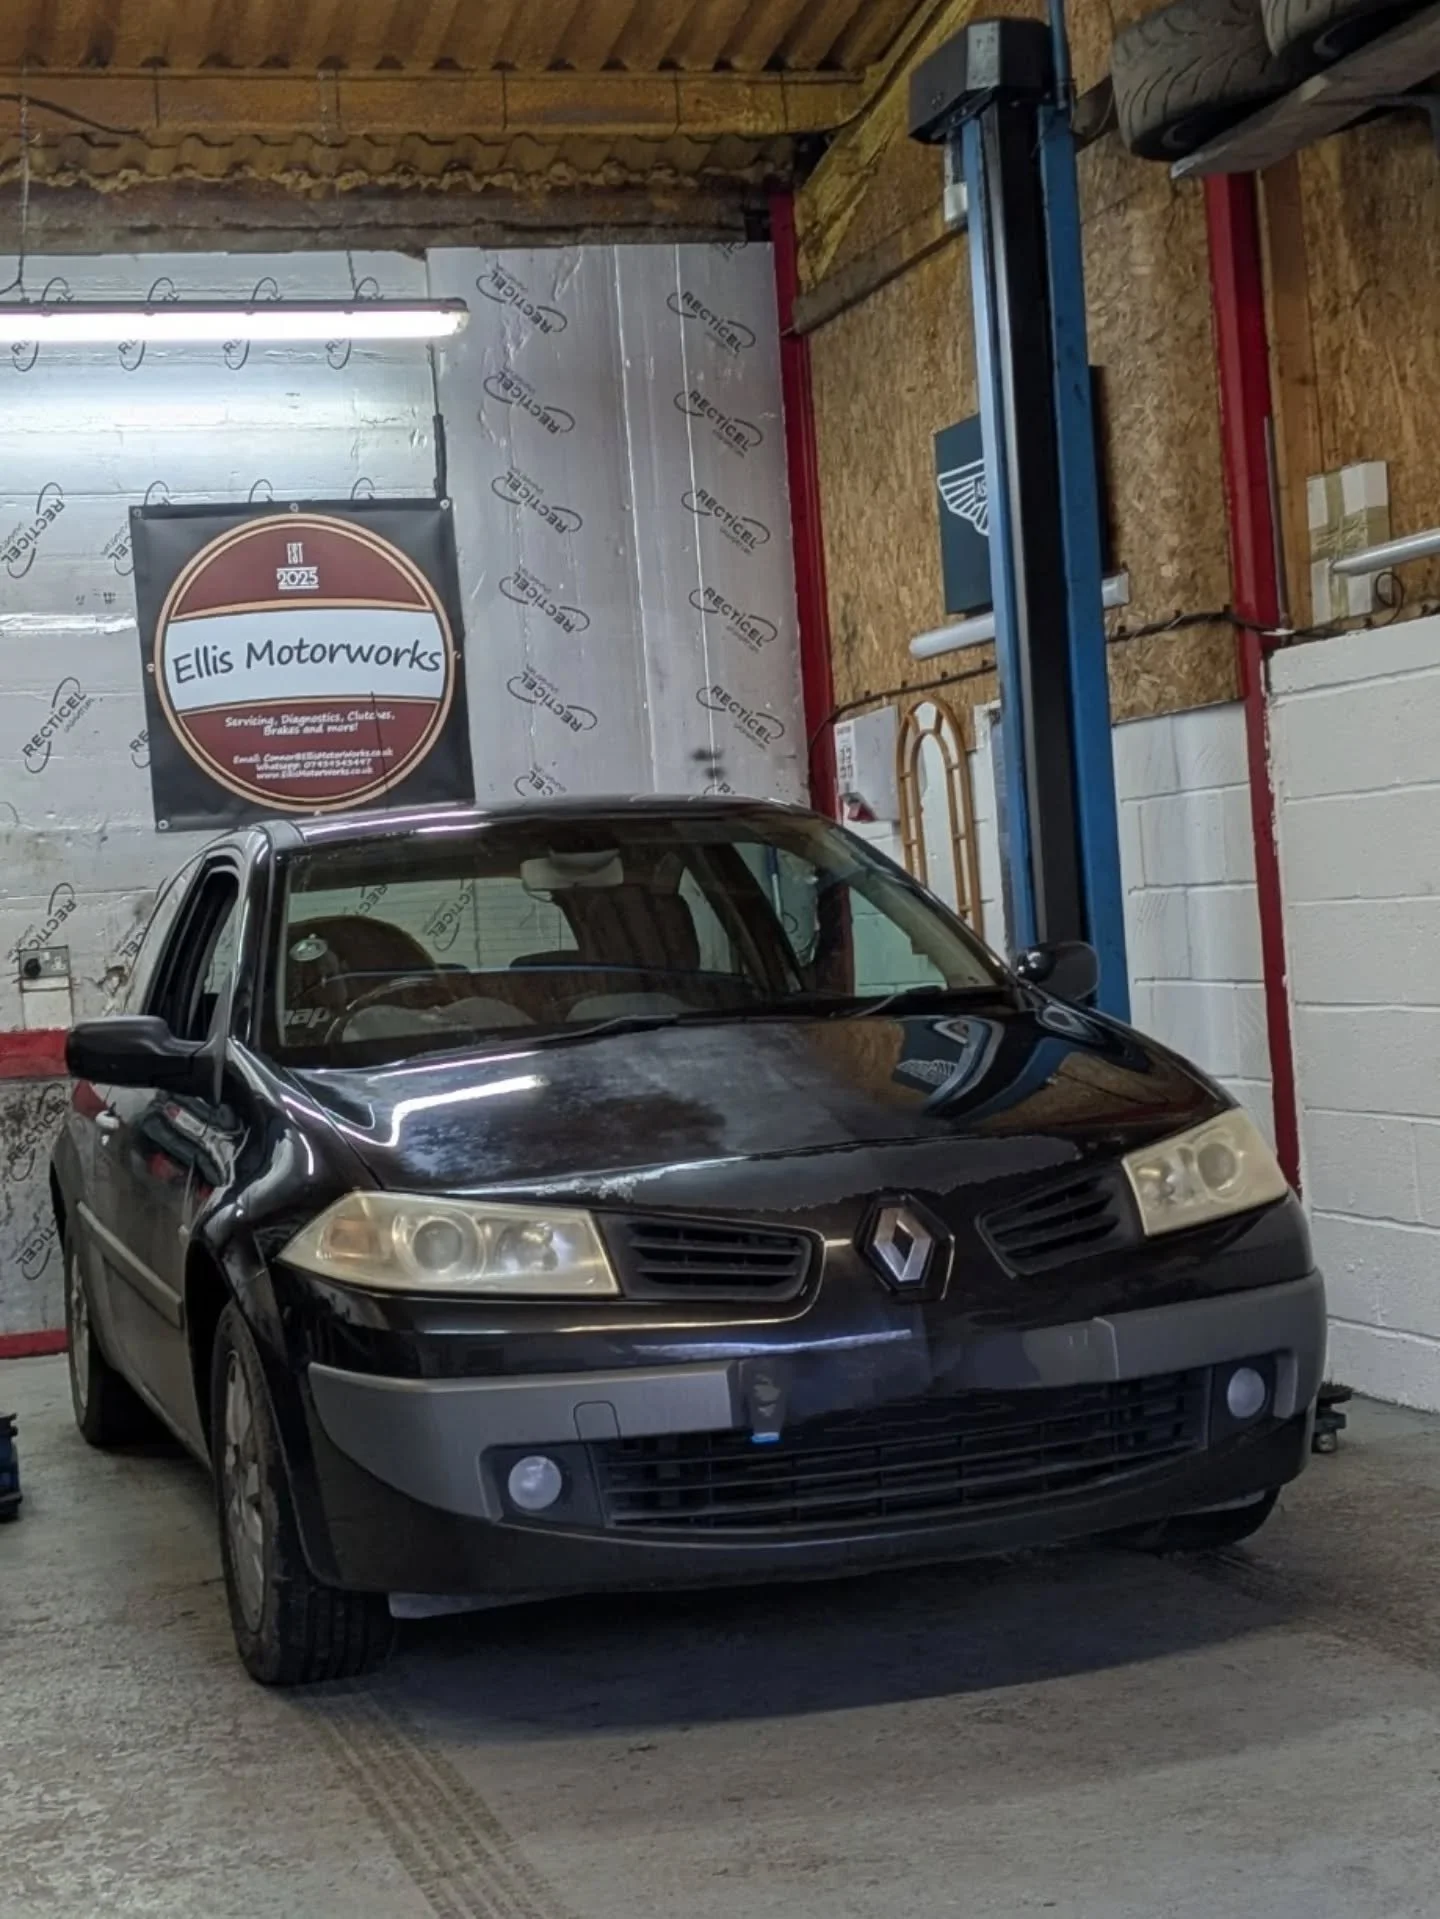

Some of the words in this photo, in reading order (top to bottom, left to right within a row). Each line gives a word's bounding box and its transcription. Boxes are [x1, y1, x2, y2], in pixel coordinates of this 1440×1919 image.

[491, 269, 553, 335] RECTICEL
[681, 291, 744, 354] RECTICEL
[497, 370, 561, 435] RECTICEL
[689, 390, 750, 452] RECTICEL
[1, 499, 65, 563] RECTICEL
[504, 470, 568, 535] RECTICEL
[696, 488, 757, 550] RECTICEL
[276, 570, 319, 586] 2025
[512, 571, 576, 634] RECTICEL
[703, 587, 766, 648] RECTICEL
[172, 644, 234, 684] Ellis
[246, 637, 442, 673] Motorworks
[22, 692, 86, 757] RECTICEL
[225, 715, 278, 728] Servicing,
[280, 712, 344, 727] Diagnostics,
[263, 726, 300, 736] Brakes
[302, 725, 323, 735] and
[327, 722, 359, 733] more!
[520, 670, 583, 733] RECTICEL
[711, 685, 772, 745] RECTICEL
[426, 885, 473, 937] CTICEL
[16, 1219, 56, 1265] TICEL
